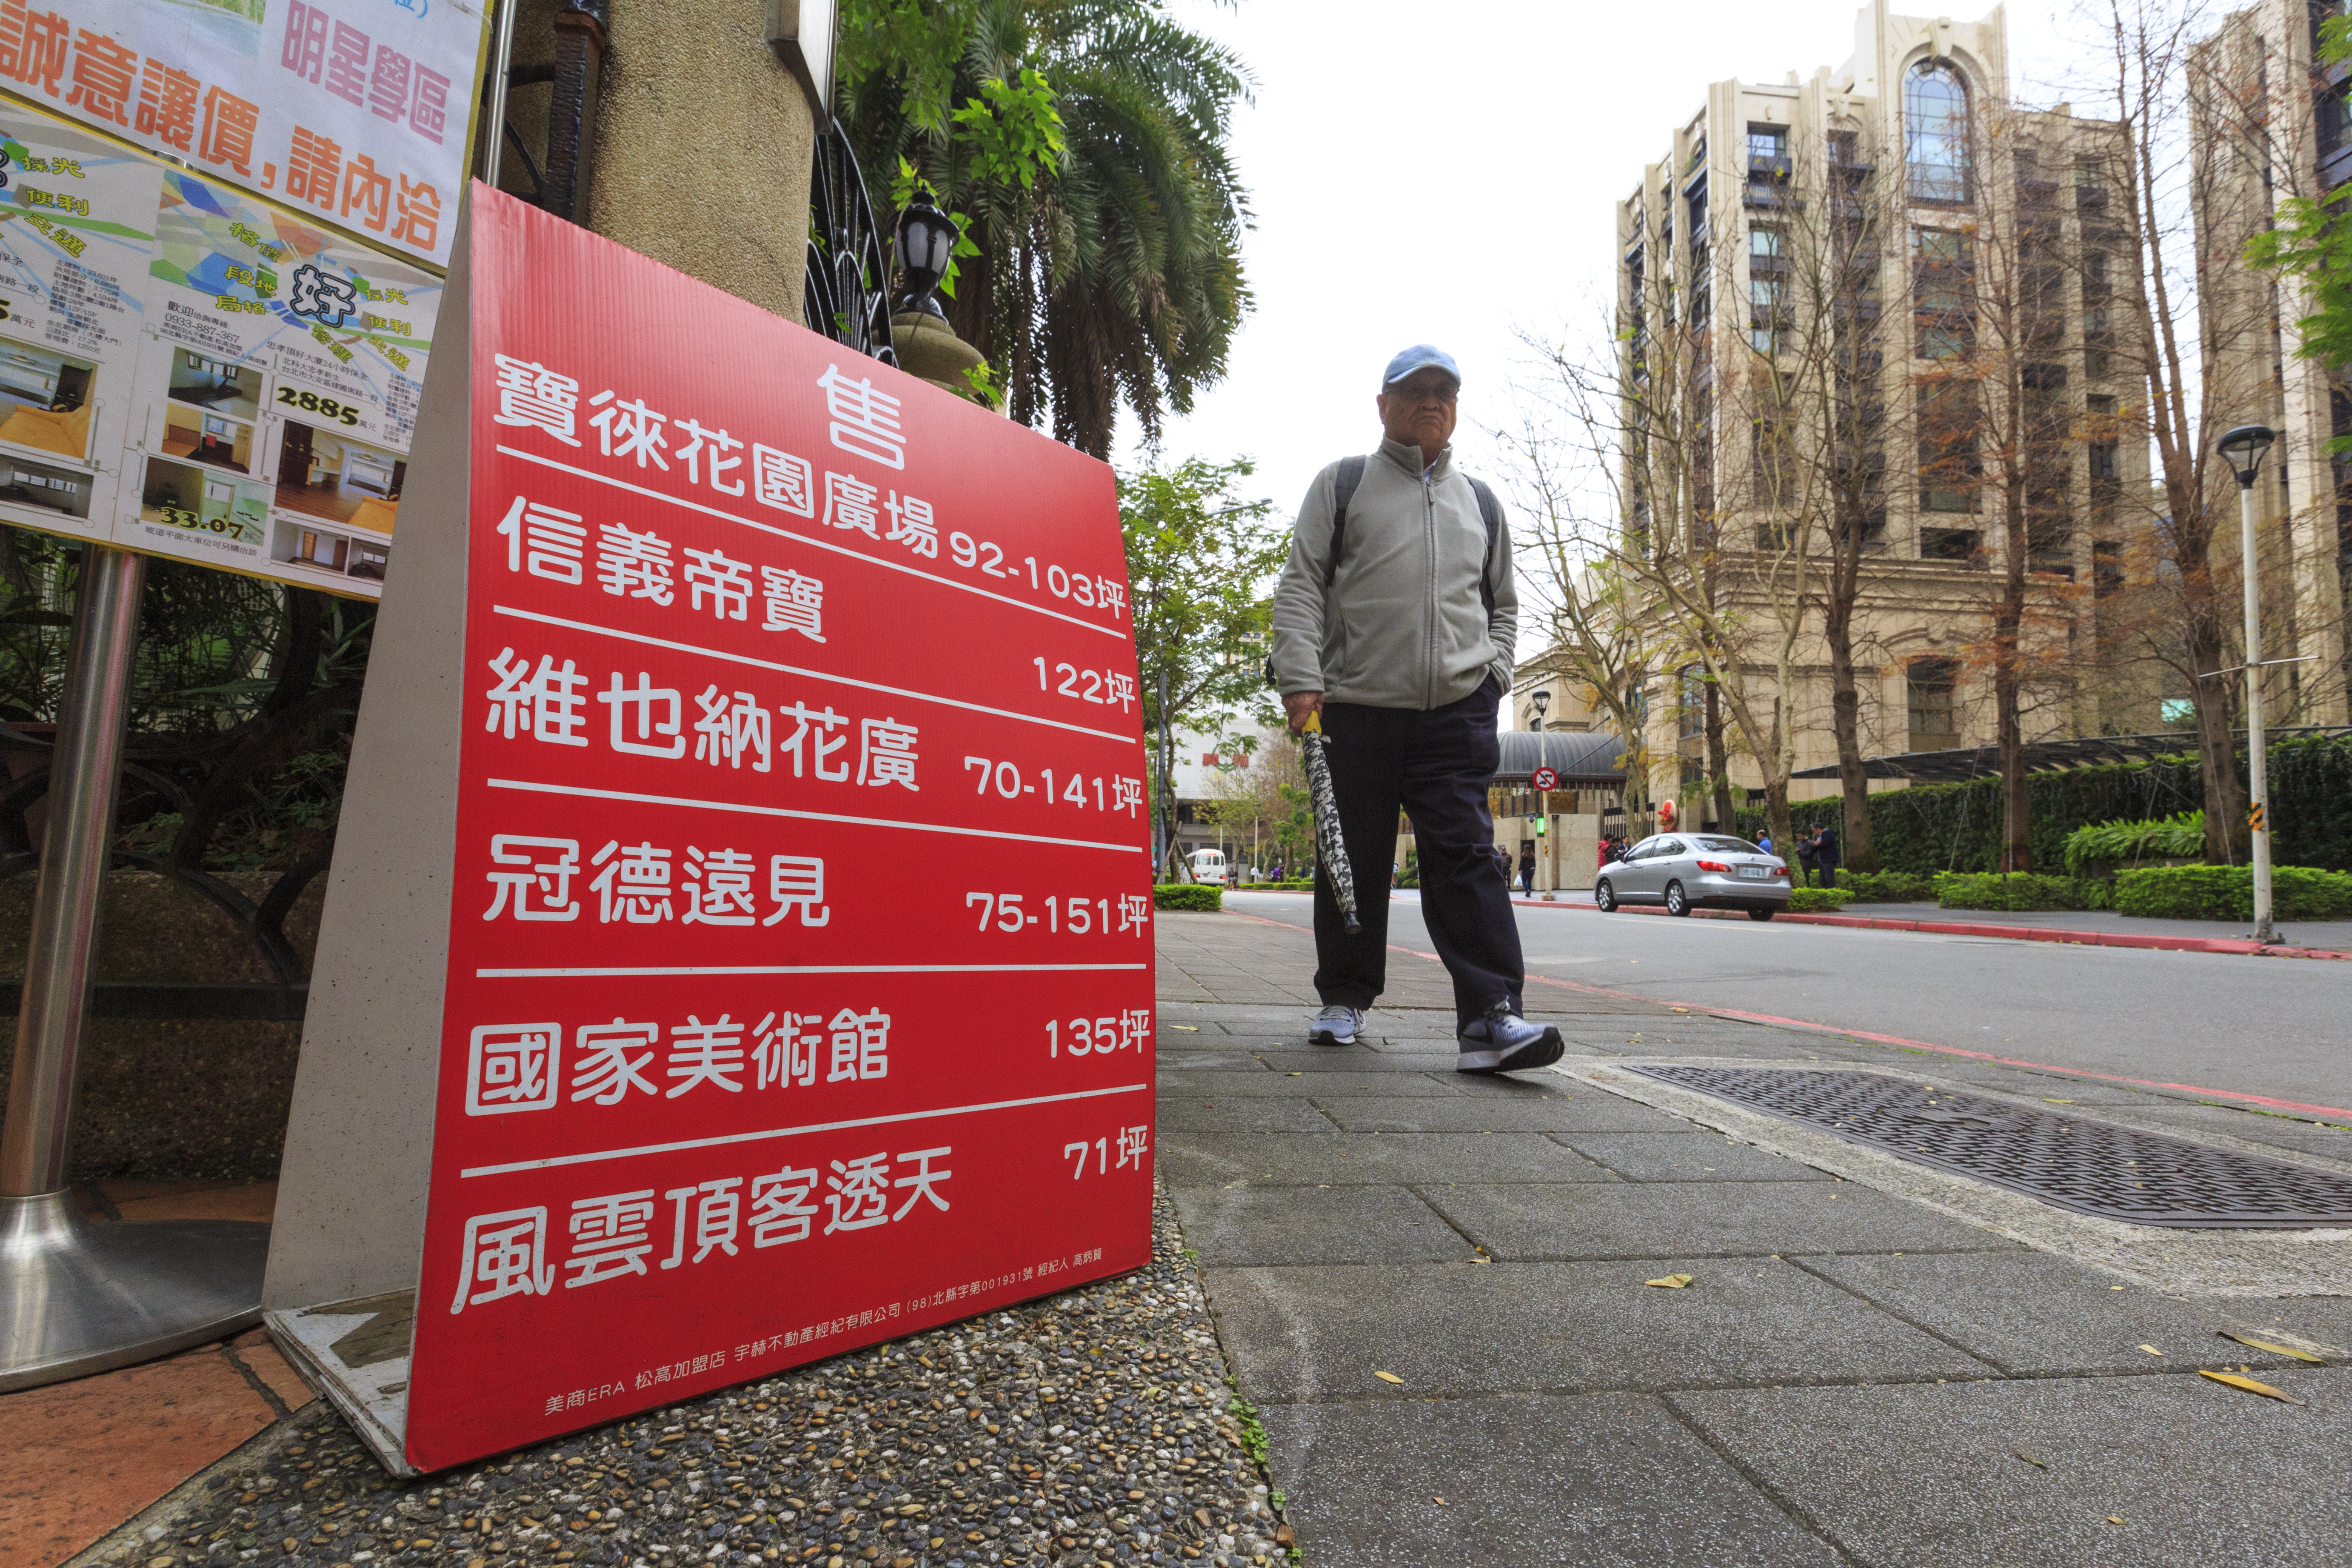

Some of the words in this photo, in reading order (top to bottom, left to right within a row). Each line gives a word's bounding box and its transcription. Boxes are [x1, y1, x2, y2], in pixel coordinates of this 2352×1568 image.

[281, 0, 451, 145] 明星學區
[21, 156, 85, 178] 採光
[26, 189, 89, 216] 便利
[24, 213, 87, 257] 交通
[290, 263, 357, 328] 好
[364, 288, 408, 305] 採光
[368, 315, 411, 336] 便利
[165, 313, 240, 343] 0933-887-367
[367, 335, 411, 371] 交通
[283, 357, 340, 382] 北科大忠孝新生
[817, 362, 906, 470] 售
[494, 353, 939, 560] 寶徠花園廣場
[950, 531, 1126, 619] 92-103坪
[144, 525, 257, 557] 坡道平面大車位可另購洽談
[497, 496, 826, 643] 信義帝寶
[1033, 657, 1135, 714] 122坪
[485, 647, 919, 791] 維也納花廣
[965, 756, 1142, 818] 70-141坪
[483, 834, 829, 927] 冠德遠見
[966, 892, 1148, 937] 75-151坪
[465, 1007, 890, 1116] 國家美術館
[1046, 1009, 1150, 1058] 135坪
[450, 1146, 951, 1314] 風雲頂客透天
[1065, 1125, 1147, 1180] 71坪
[545, 1381, 625, 1416] 美商ERA
[634, 1350, 726, 1391] 松高加盟店
[734, 1302, 901, 1362] 宇赫不動產經紀有限公司
[1037, 1257, 1068, 1277] 經紀人
[1072, 1248, 1103, 1268] 高炳賢
